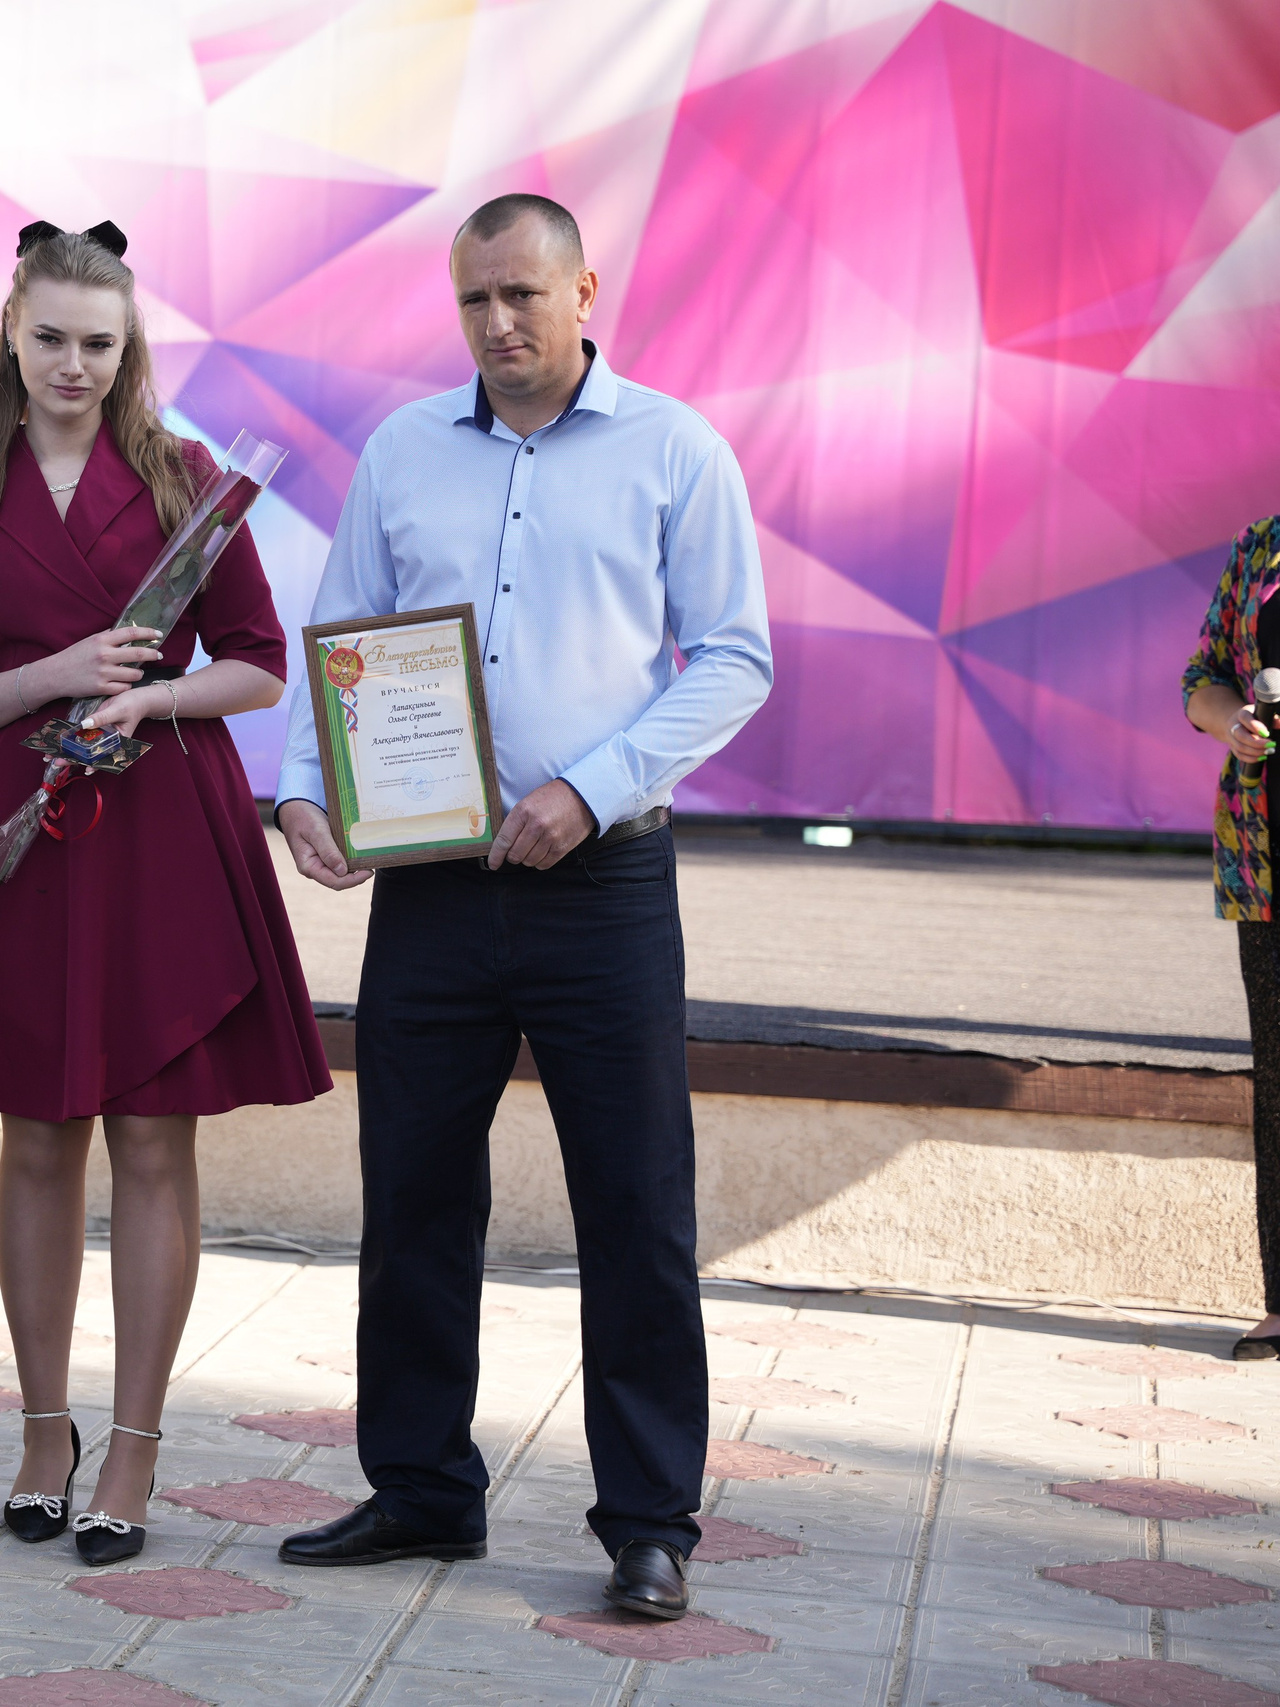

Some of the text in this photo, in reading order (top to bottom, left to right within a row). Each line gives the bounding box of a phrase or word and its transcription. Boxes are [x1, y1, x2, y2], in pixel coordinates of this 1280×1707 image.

[364, 644, 457, 664] Благодарственное
[398, 655, 459, 674] ПИСЬМО
[381, 682, 441, 696] ВРУЧАЕТСЯ
[390, 701, 436, 713] Лапаксиным
[388, 710, 442, 724] Ольге Сергеевне
[371, 727, 464, 747] Александру Вячеславовичу
